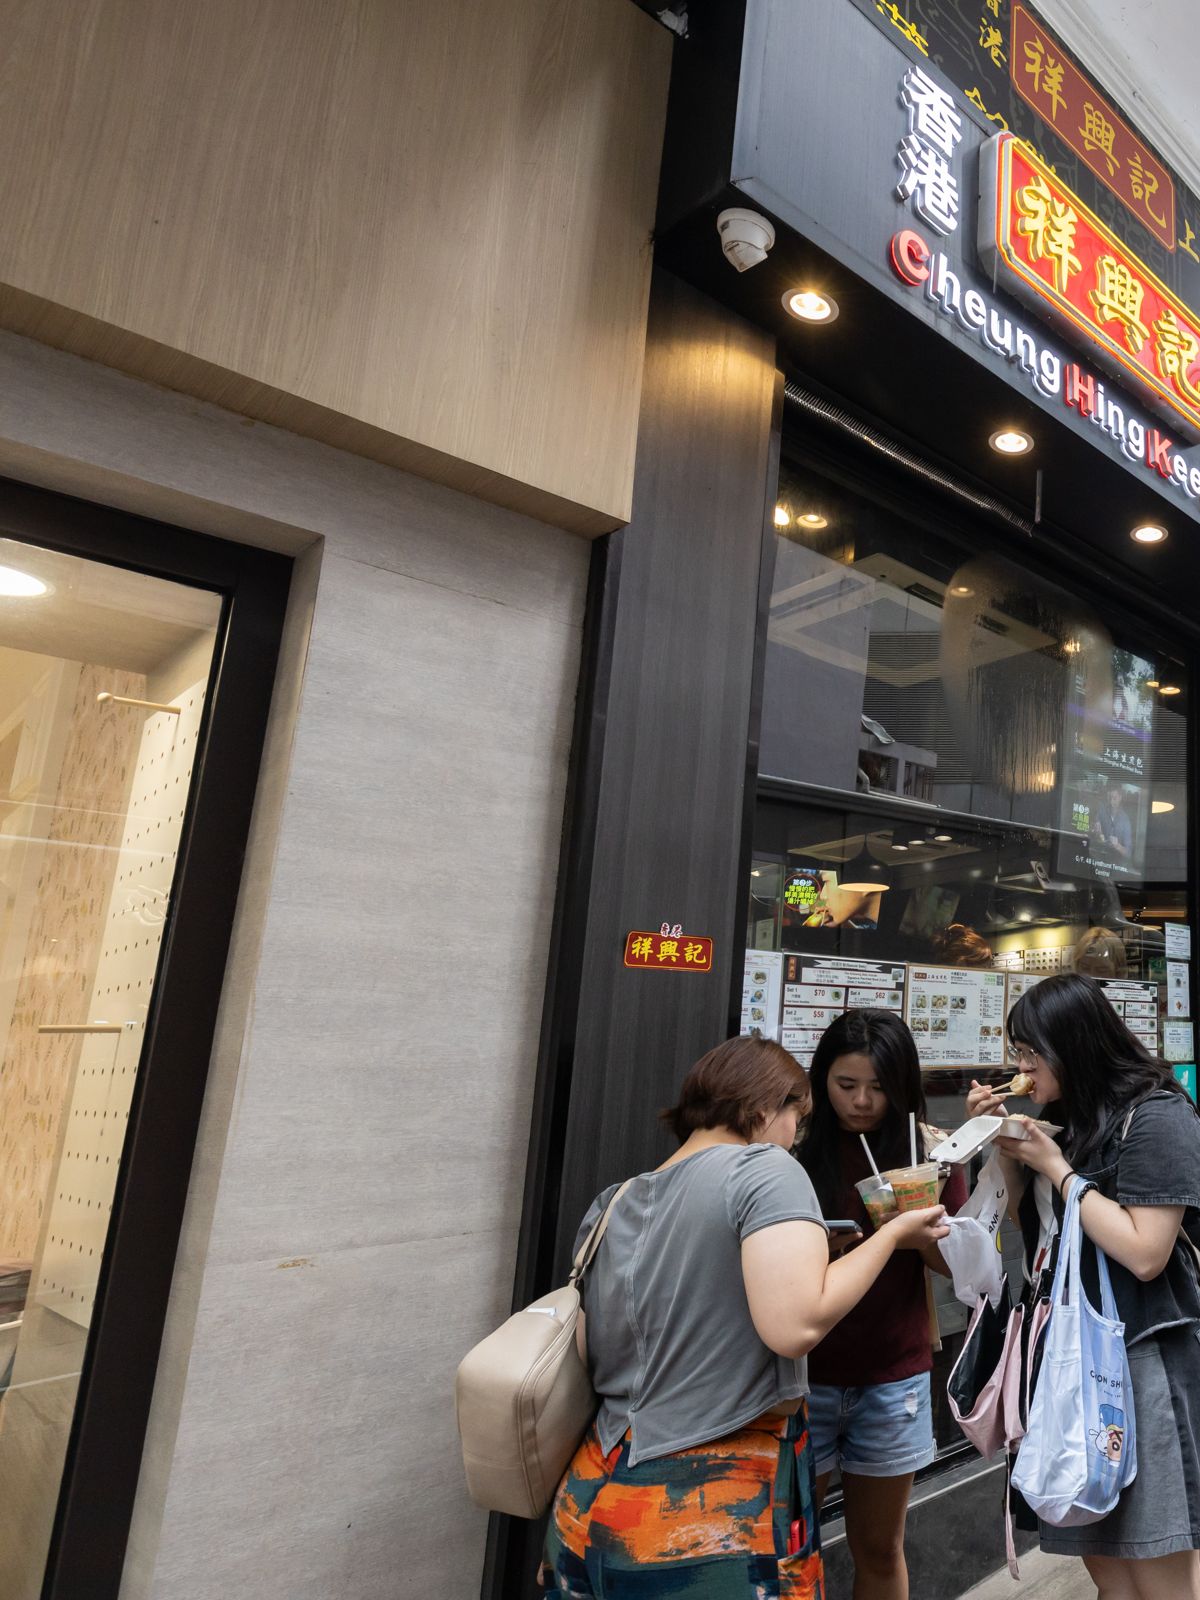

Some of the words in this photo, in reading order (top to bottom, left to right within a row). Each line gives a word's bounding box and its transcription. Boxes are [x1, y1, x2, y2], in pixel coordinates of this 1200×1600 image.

[898, 65, 962, 236] 香港
[1023, 35, 1167, 229] 祥興記
[890, 229, 1061, 397] Cheung
[1064, 363, 1145, 461] Hing
[631, 936, 707, 964] 祥興記
[660, 922, 683, 939] 香港
[814, 989, 825, 997] $70
